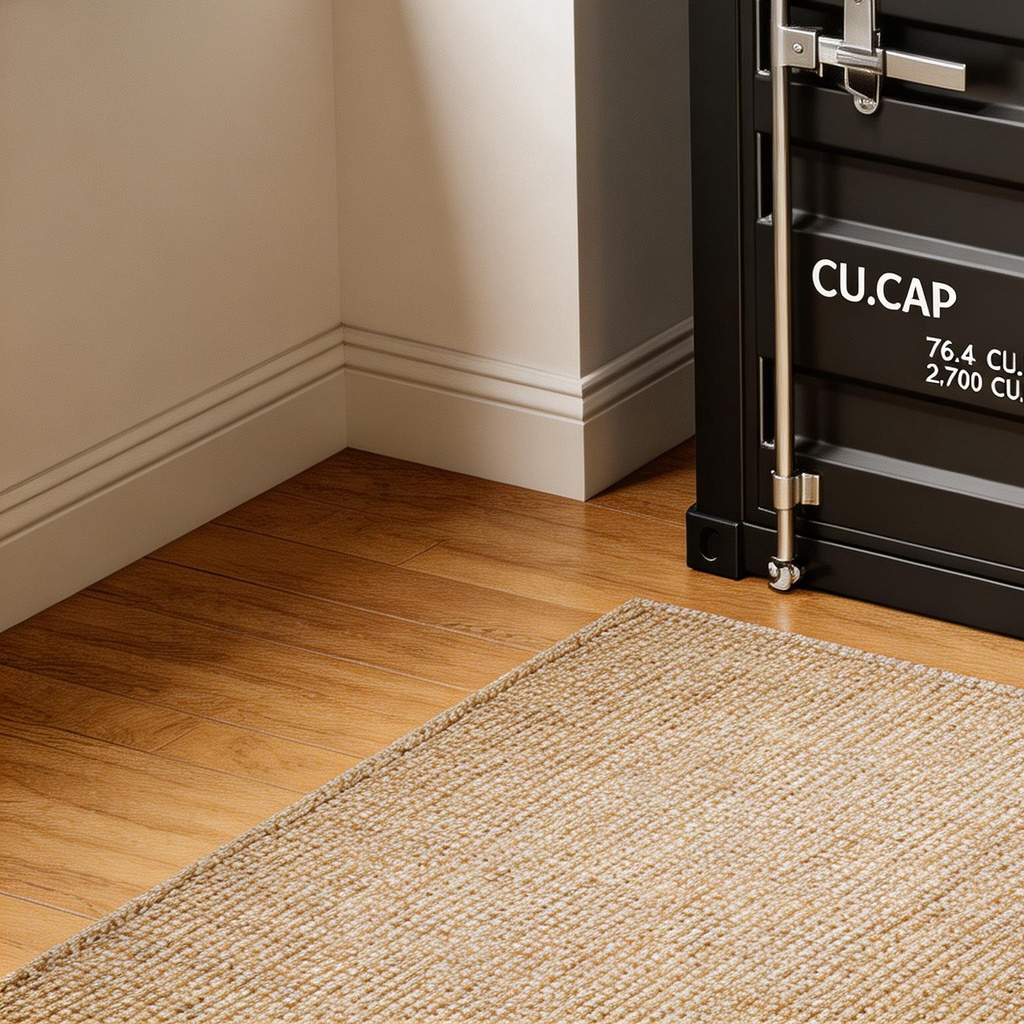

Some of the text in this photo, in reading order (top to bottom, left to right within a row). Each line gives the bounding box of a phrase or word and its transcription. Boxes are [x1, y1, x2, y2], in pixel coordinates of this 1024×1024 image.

[812, 259, 957, 318] CU.CAP
[926, 336, 976, 365] 76.4
[926, 364, 983, 392] 2,700
